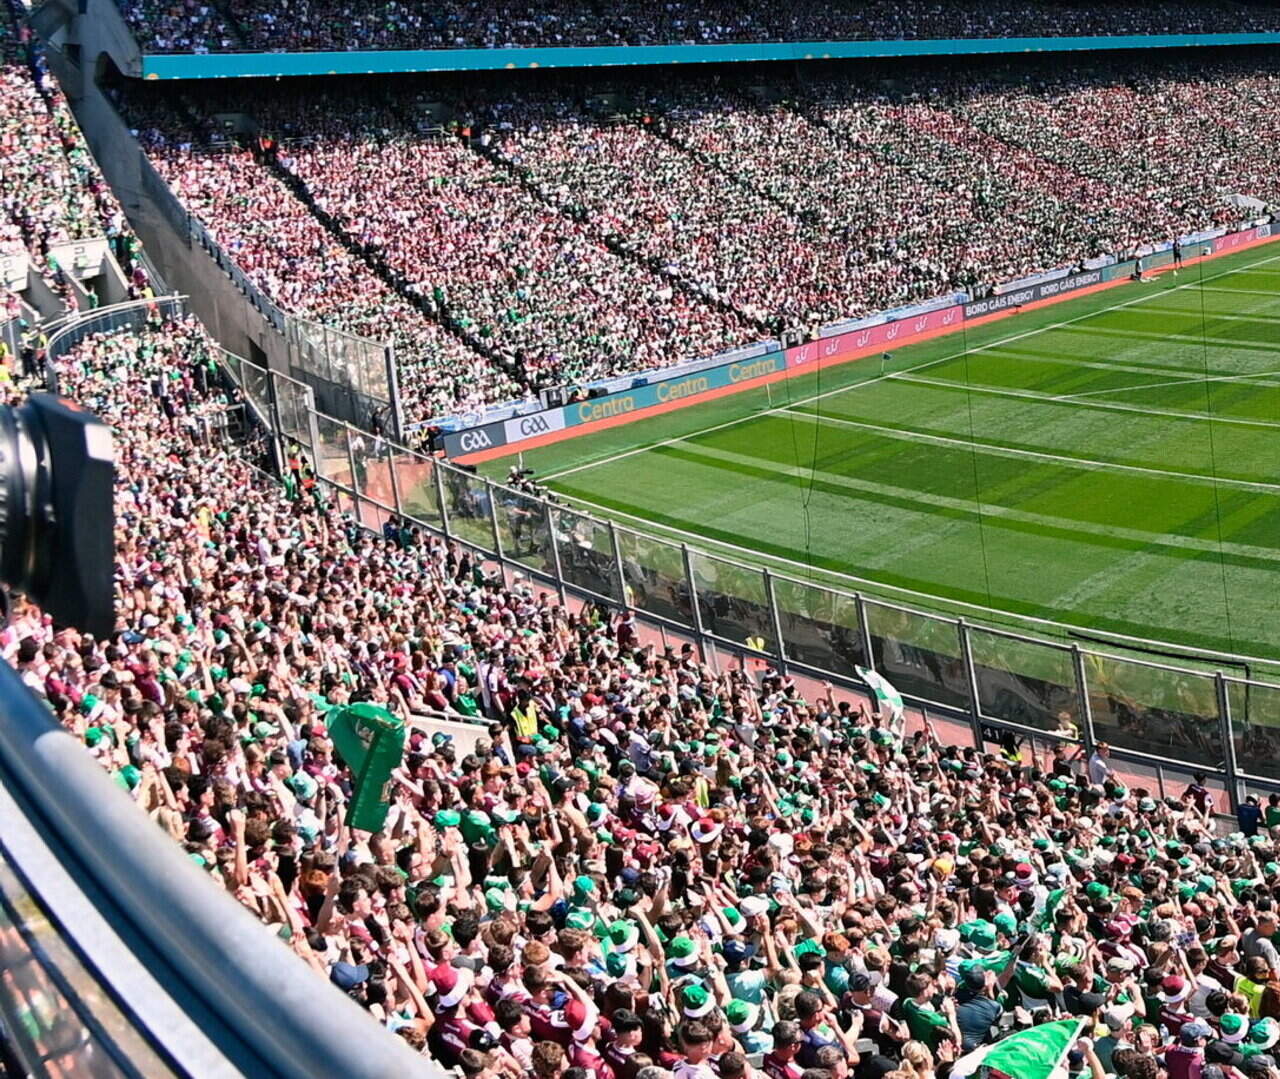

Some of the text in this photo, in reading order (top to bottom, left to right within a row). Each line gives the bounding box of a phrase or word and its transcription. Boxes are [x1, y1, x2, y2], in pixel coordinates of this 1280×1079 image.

[1040, 283, 1060, 296] BORD
[1075, 271, 1100, 286] ENERGY
[966, 303, 988, 317] BORD
[1007, 290, 1034, 306] ENERGY
[728, 358, 777, 384] Centra
[656, 376, 708, 403] Centra
[578, 395, 635, 423] Centra
